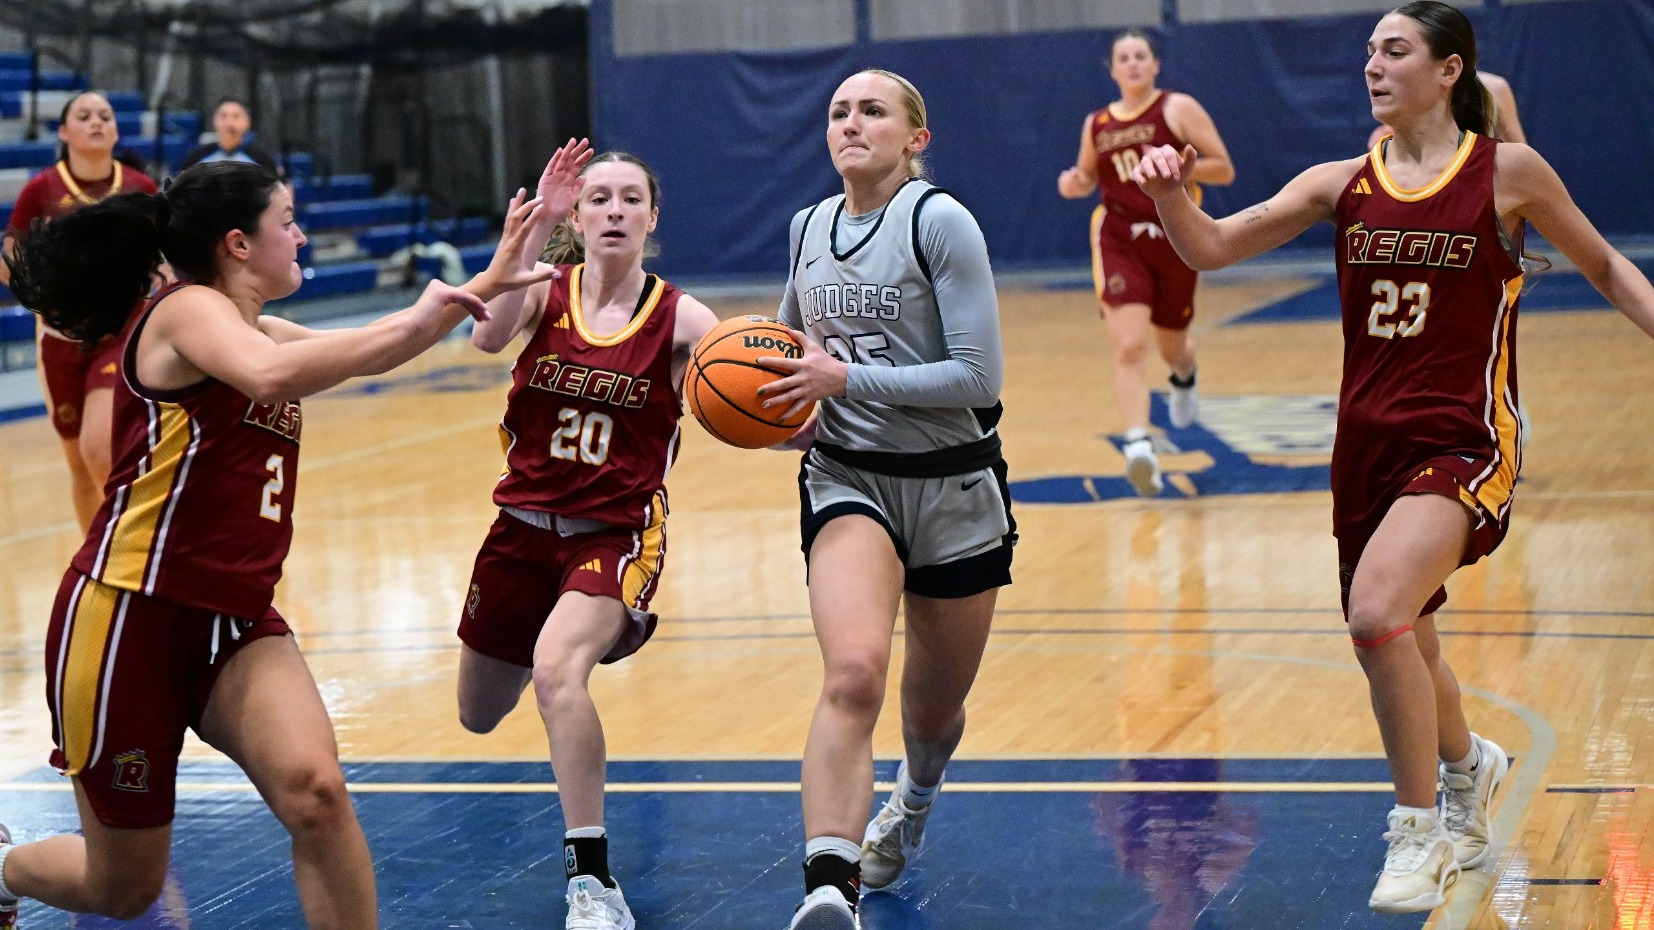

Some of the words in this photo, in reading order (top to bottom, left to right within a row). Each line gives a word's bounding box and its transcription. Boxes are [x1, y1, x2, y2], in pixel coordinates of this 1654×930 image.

[1347, 229, 1477, 268] REGIS
[804, 283, 902, 326] JUDGES
[1367, 279, 1431, 339] 23
[742, 334, 802, 359] ilson
[529, 360, 651, 409] REGIS
[550, 407, 614, 466] 20
[259, 453, 284, 523] 2
[112, 752, 149, 792] R
